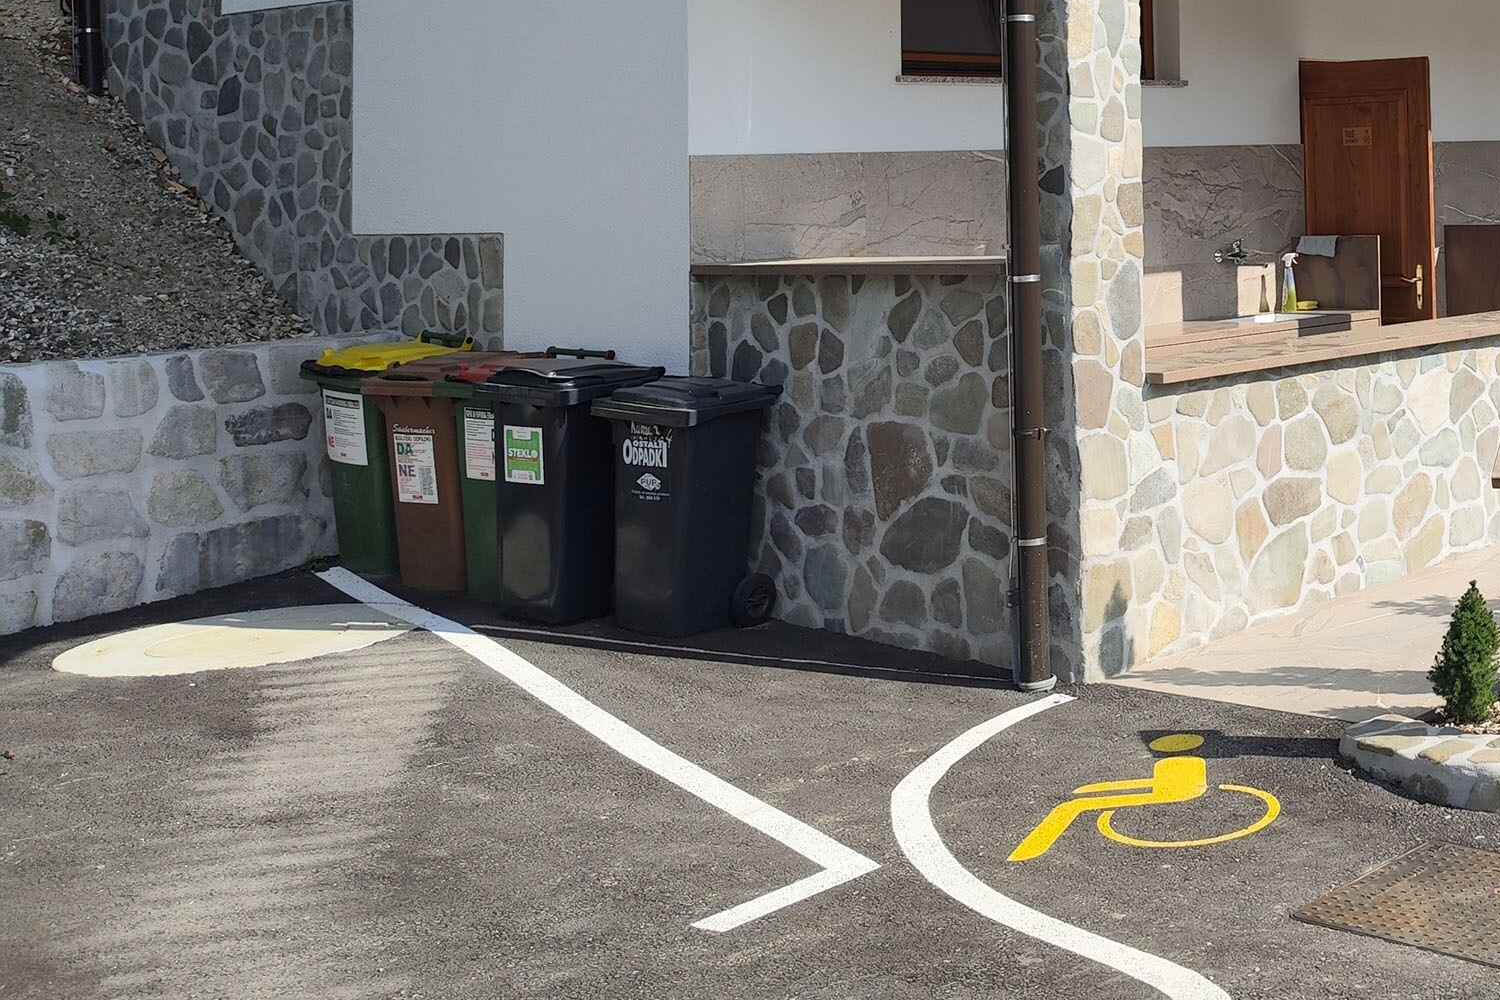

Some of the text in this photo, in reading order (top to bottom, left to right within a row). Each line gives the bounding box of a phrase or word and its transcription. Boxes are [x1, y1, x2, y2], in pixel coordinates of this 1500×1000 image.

[392, 423, 435, 434] Saubermacher
[396, 442, 414, 456] DA
[632, 440, 662, 448] OSTALI
[508, 447, 538, 459] STEKLO
[623, 438, 667, 468] ODPADKI
[398, 464, 417, 477] NE
